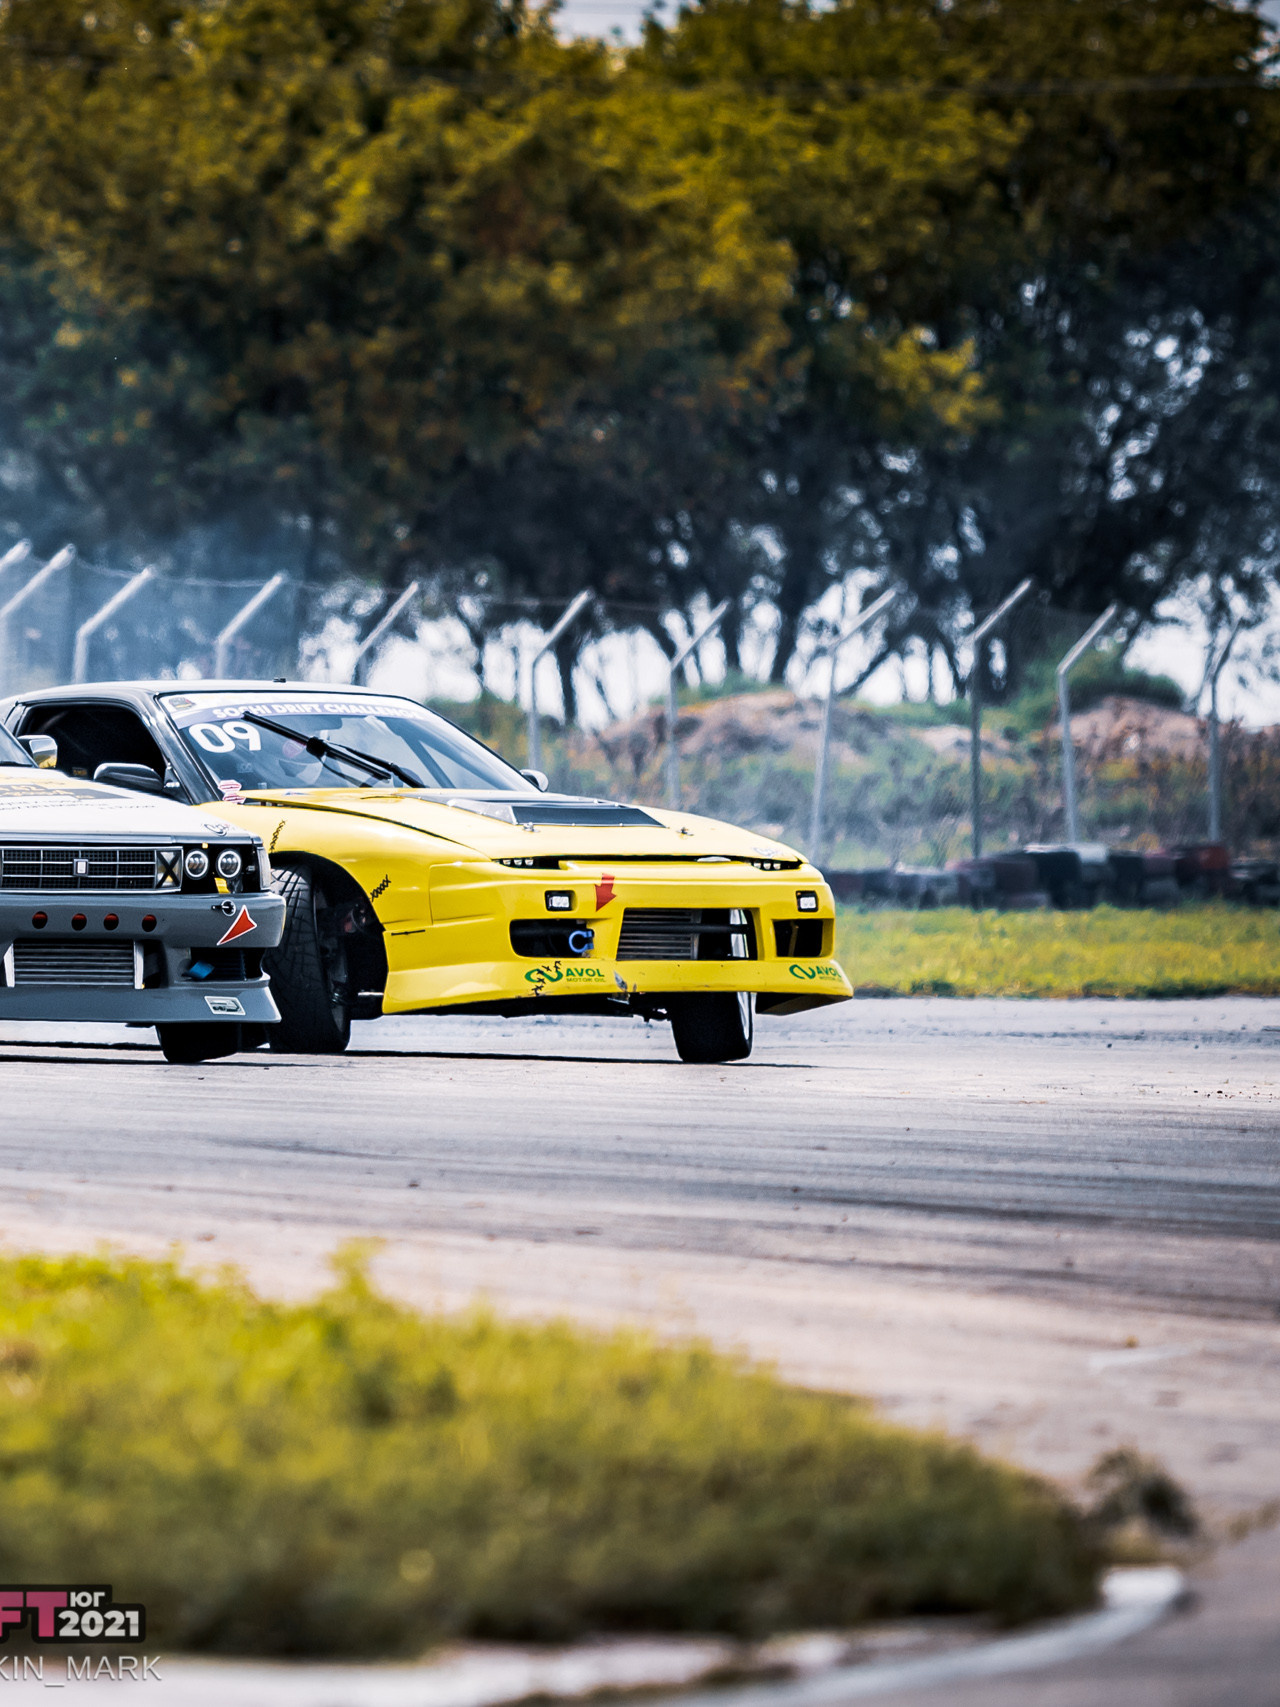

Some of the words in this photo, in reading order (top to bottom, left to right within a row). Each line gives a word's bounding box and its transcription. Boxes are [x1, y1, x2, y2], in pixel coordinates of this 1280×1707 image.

[271, 703, 322, 714] DRIFT
[188, 721, 262, 754] 09
[566, 967, 605, 977] AVOL
